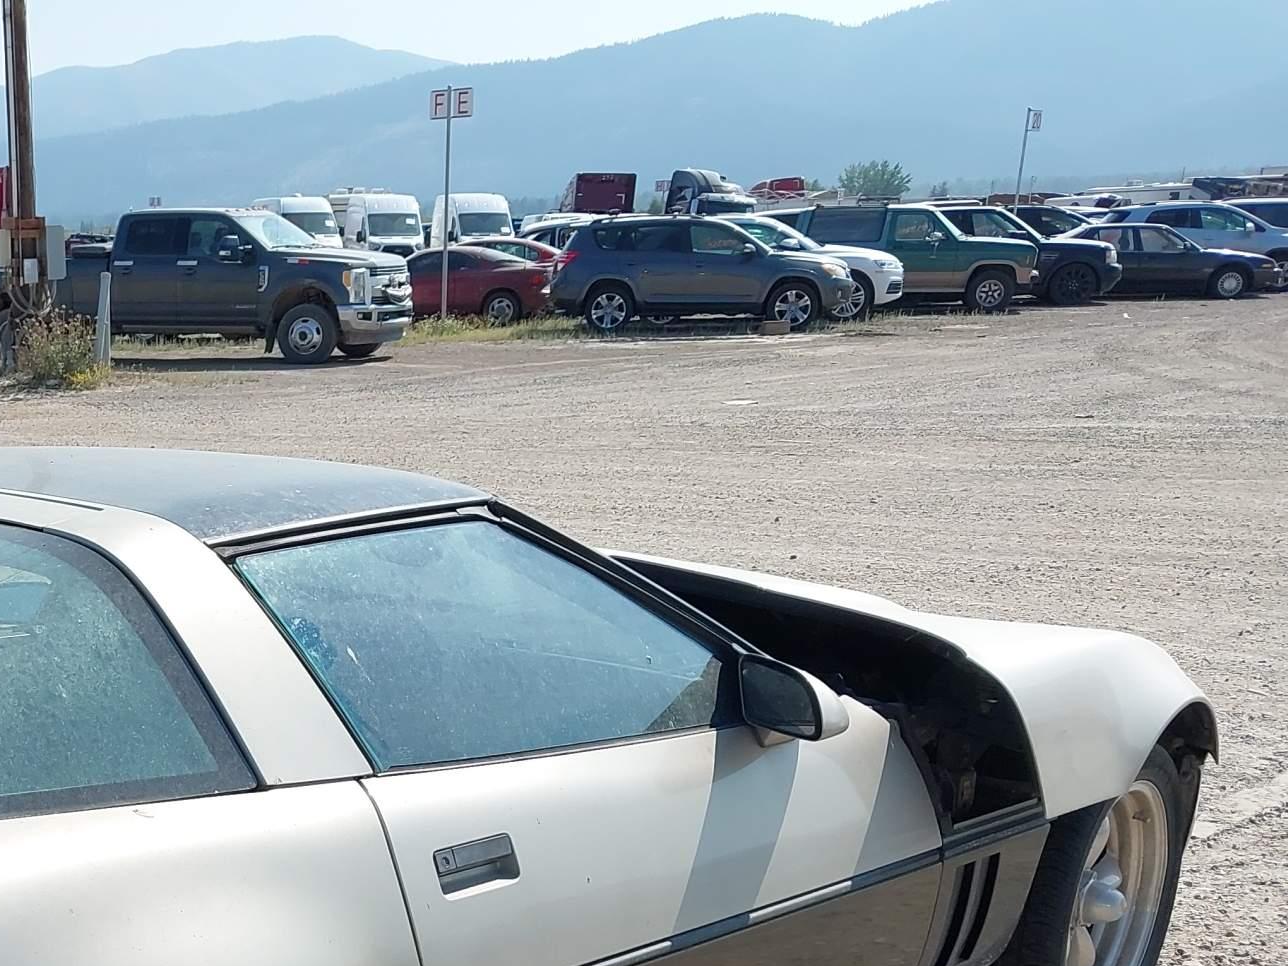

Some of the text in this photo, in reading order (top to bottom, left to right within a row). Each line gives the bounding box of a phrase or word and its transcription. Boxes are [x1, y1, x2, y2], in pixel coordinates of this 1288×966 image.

[434, 93, 445, 116] F
[458, 91, 469, 114] E
[1032, 112, 1042, 129] 20
